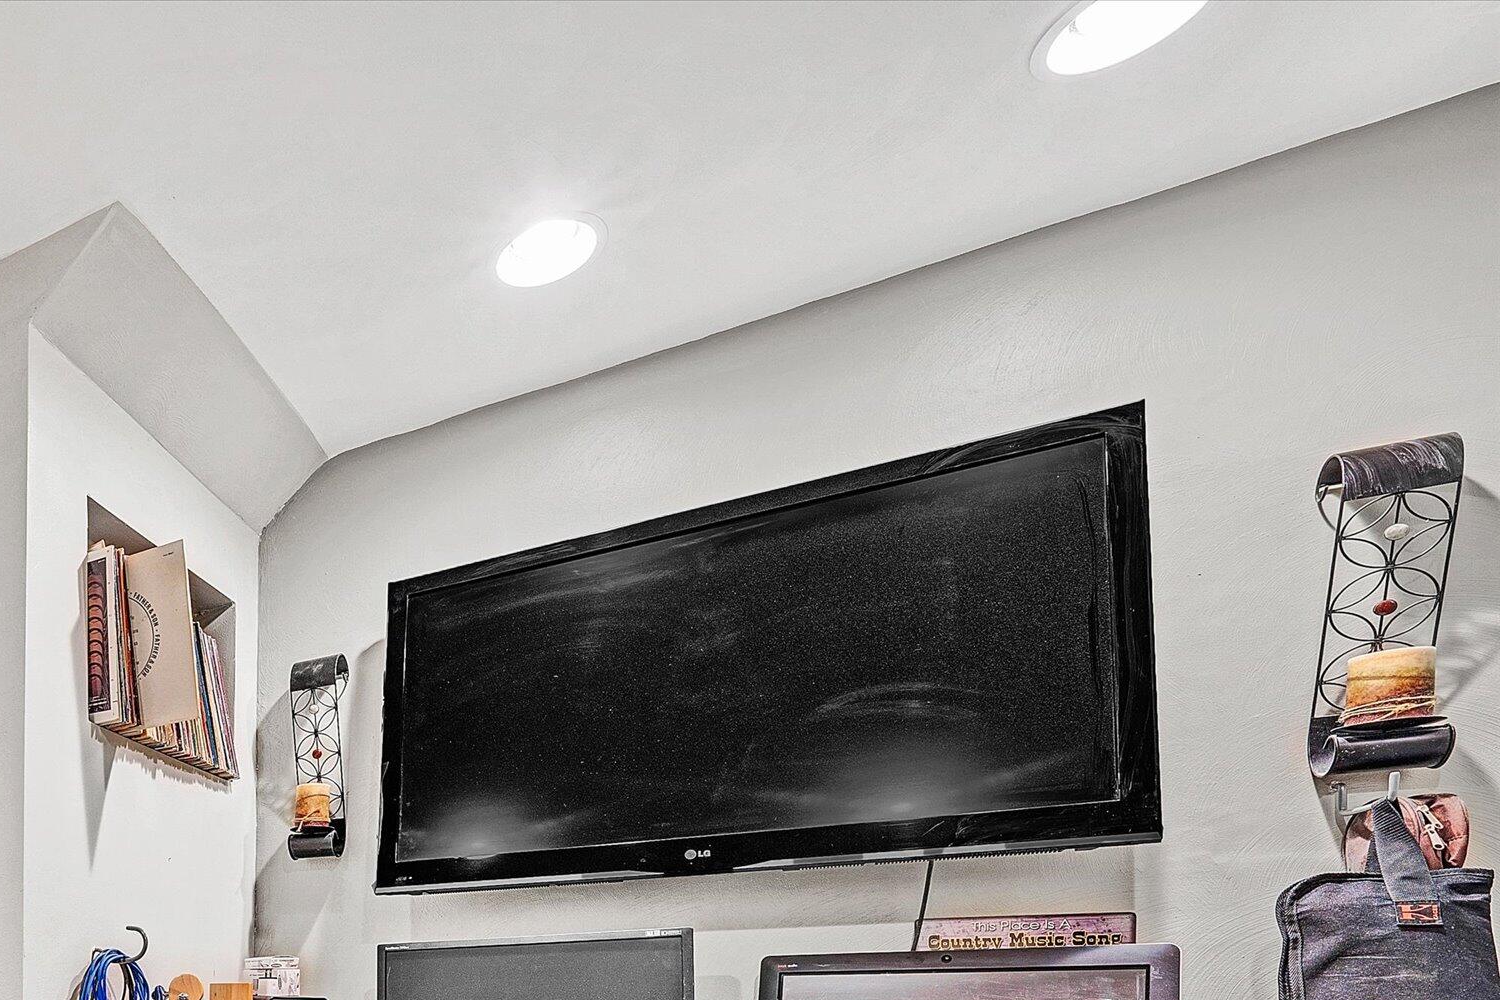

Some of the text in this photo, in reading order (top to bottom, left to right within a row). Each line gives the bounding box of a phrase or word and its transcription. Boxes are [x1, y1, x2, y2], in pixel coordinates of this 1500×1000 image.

[971, 918, 1072, 932] This Place Is A
[928, 930, 1123, 950] Country Music Song
